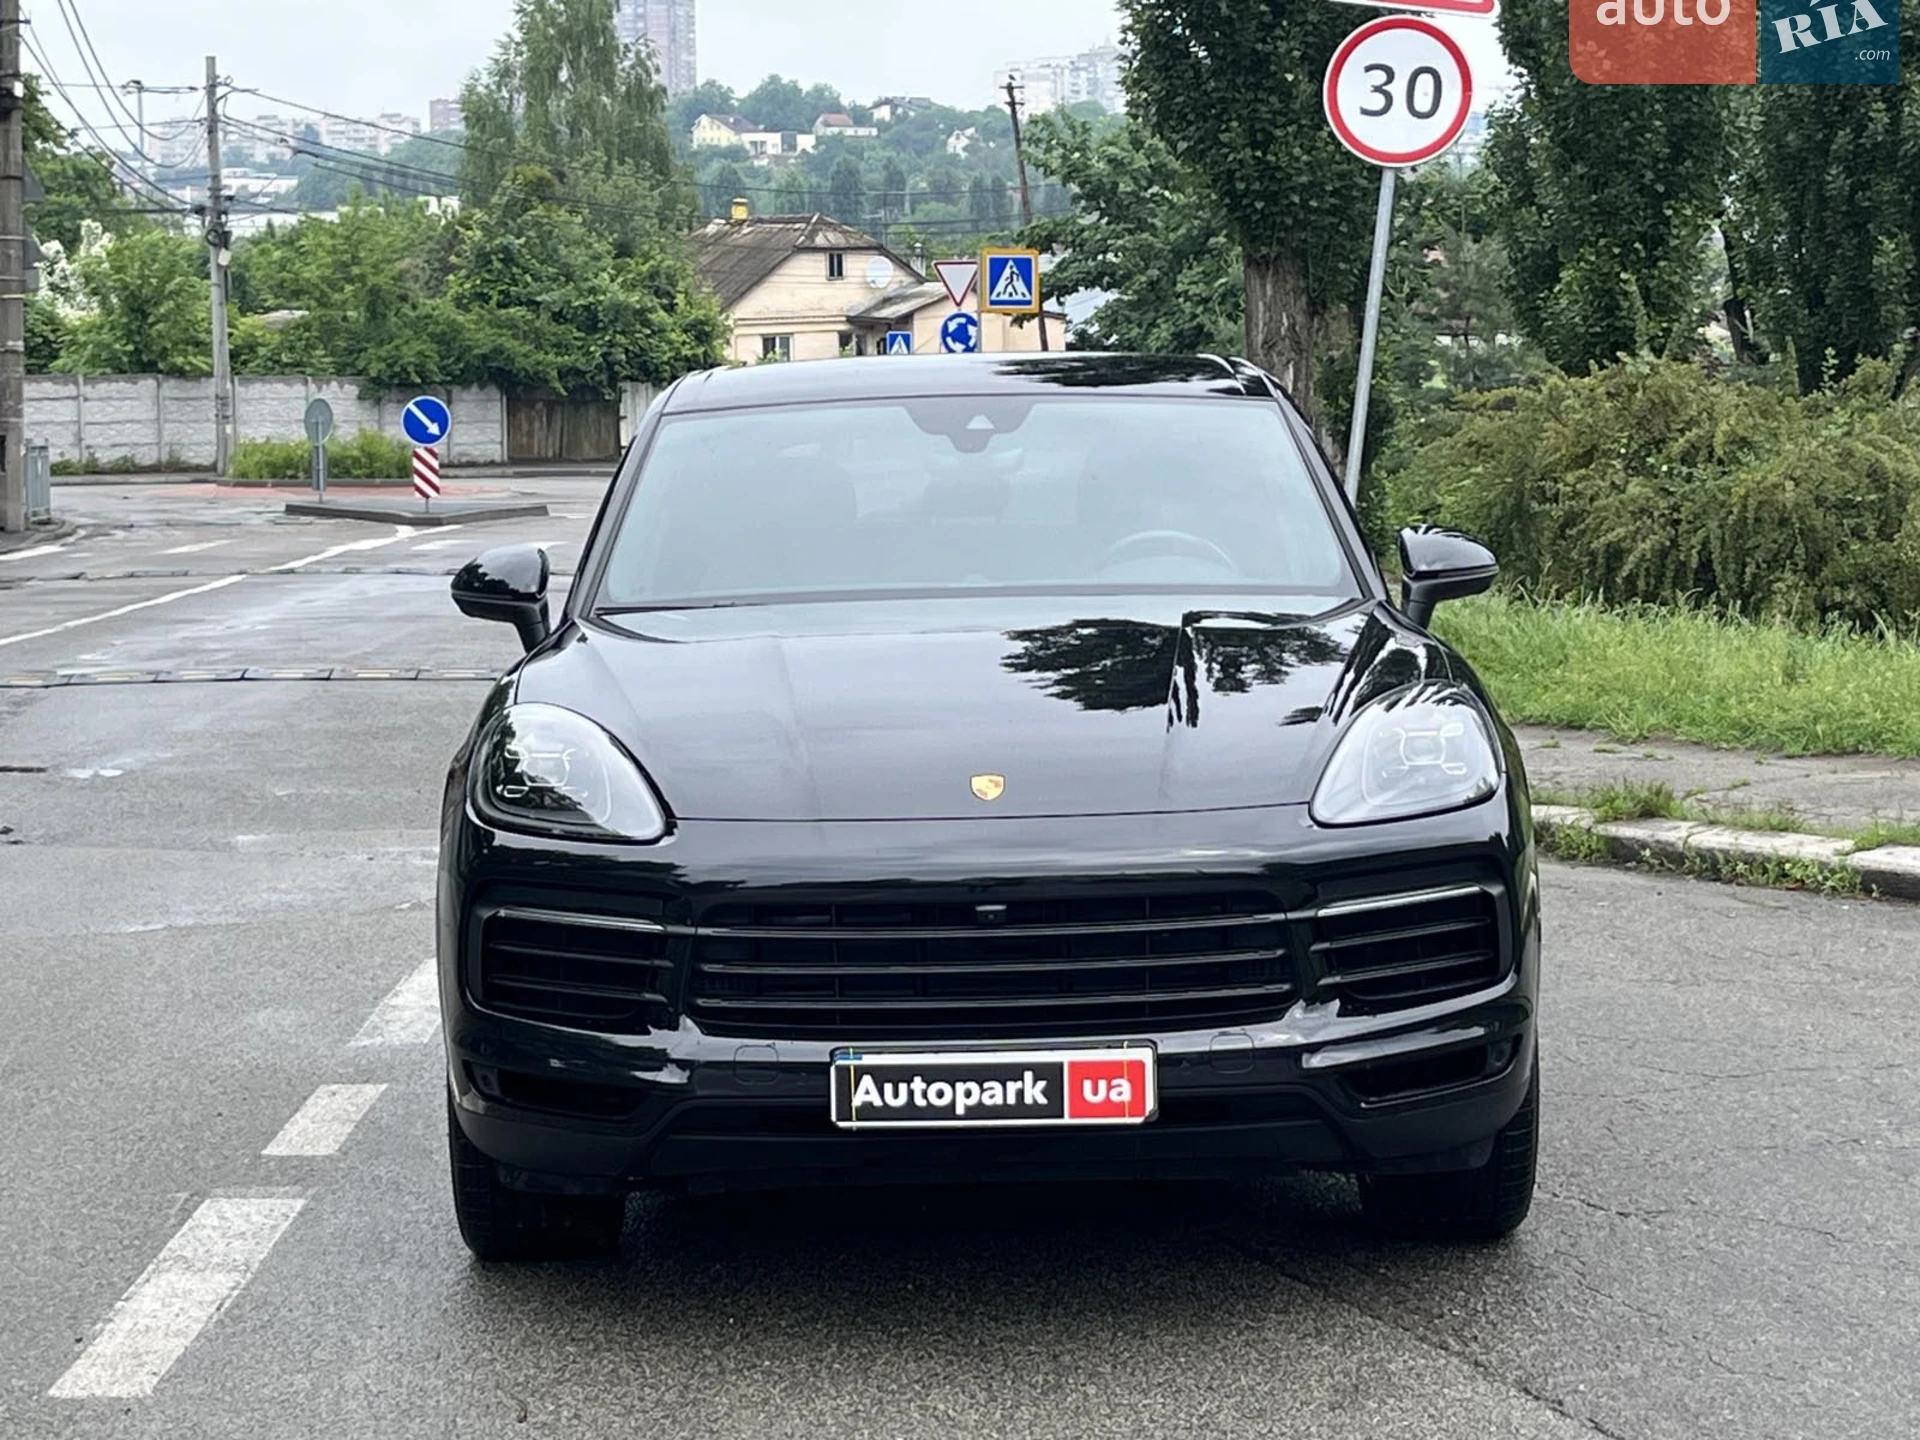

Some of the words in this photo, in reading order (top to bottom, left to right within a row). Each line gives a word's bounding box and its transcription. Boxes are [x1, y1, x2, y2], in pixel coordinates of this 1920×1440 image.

[1359, 63, 1443, 120] 30
[853, 1070, 1048, 1115] Autopark
[1082, 1077, 1132, 1103] ua
